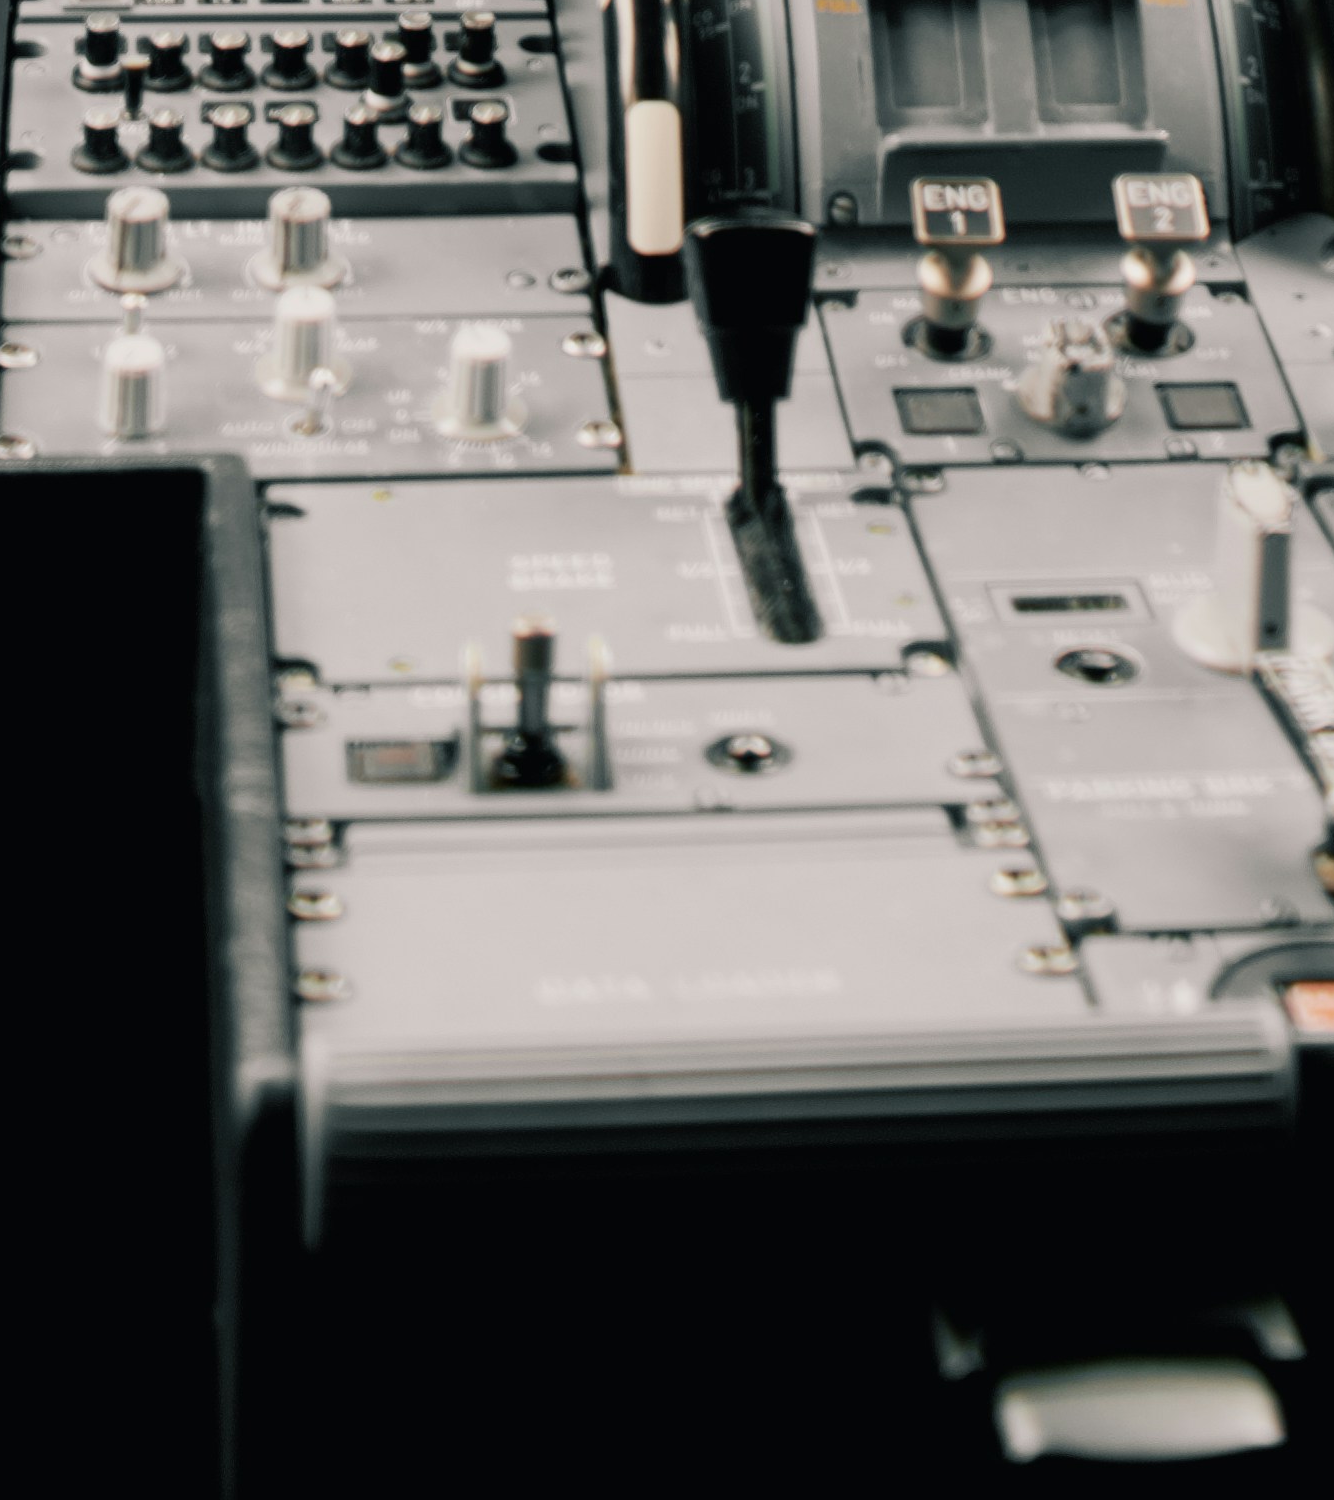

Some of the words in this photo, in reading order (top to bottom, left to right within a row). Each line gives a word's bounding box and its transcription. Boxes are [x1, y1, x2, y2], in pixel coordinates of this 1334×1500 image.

[924, 185, 988, 211] ENG
[1127, 181, 1191, 206] ENG
[950, 211, 964, 235] 1
[1154, 207, 1173, 231] 2
